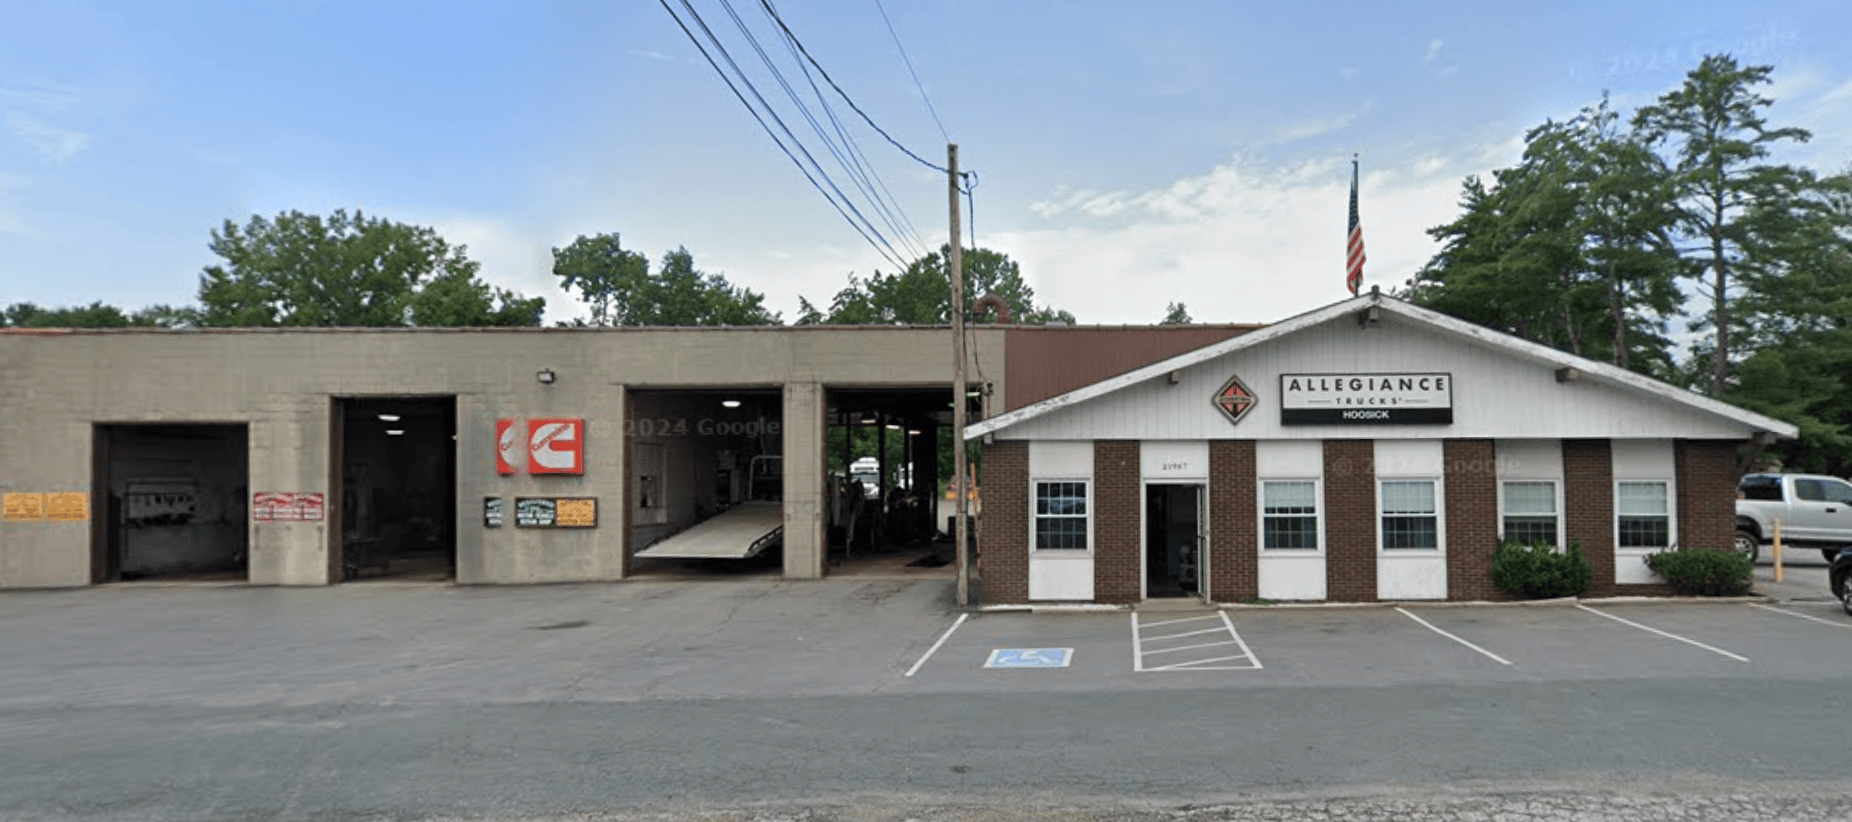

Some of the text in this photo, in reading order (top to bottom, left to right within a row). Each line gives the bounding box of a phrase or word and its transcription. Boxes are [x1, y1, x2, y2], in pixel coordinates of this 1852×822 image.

[1288, 377, 1445, 392] ALLEGIANCE
[1335, 397, 1399, 406] TRUCKS
[1342, 410, 1390, 420] HOOSICK
